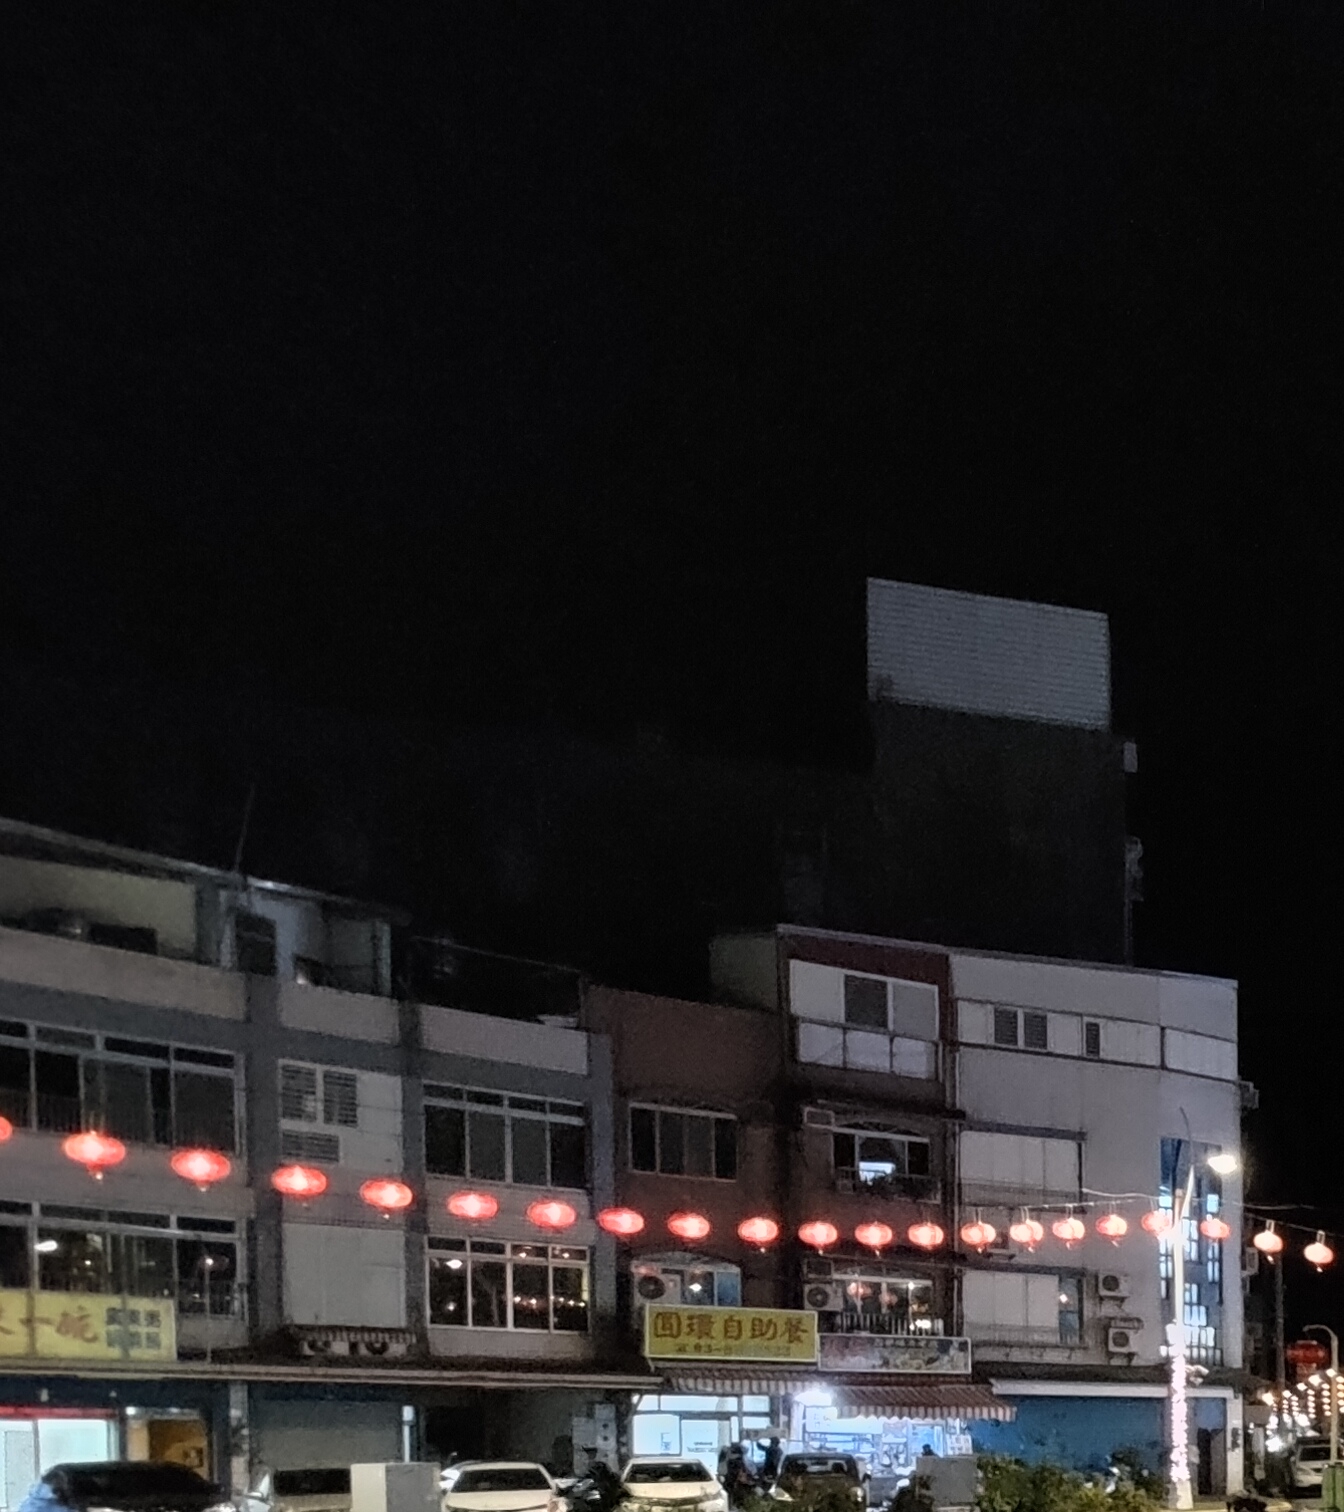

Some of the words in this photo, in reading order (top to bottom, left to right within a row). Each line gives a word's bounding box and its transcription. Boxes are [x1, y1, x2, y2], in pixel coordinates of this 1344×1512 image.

[654, 1311, 808, 1344] 圓環自助餐
